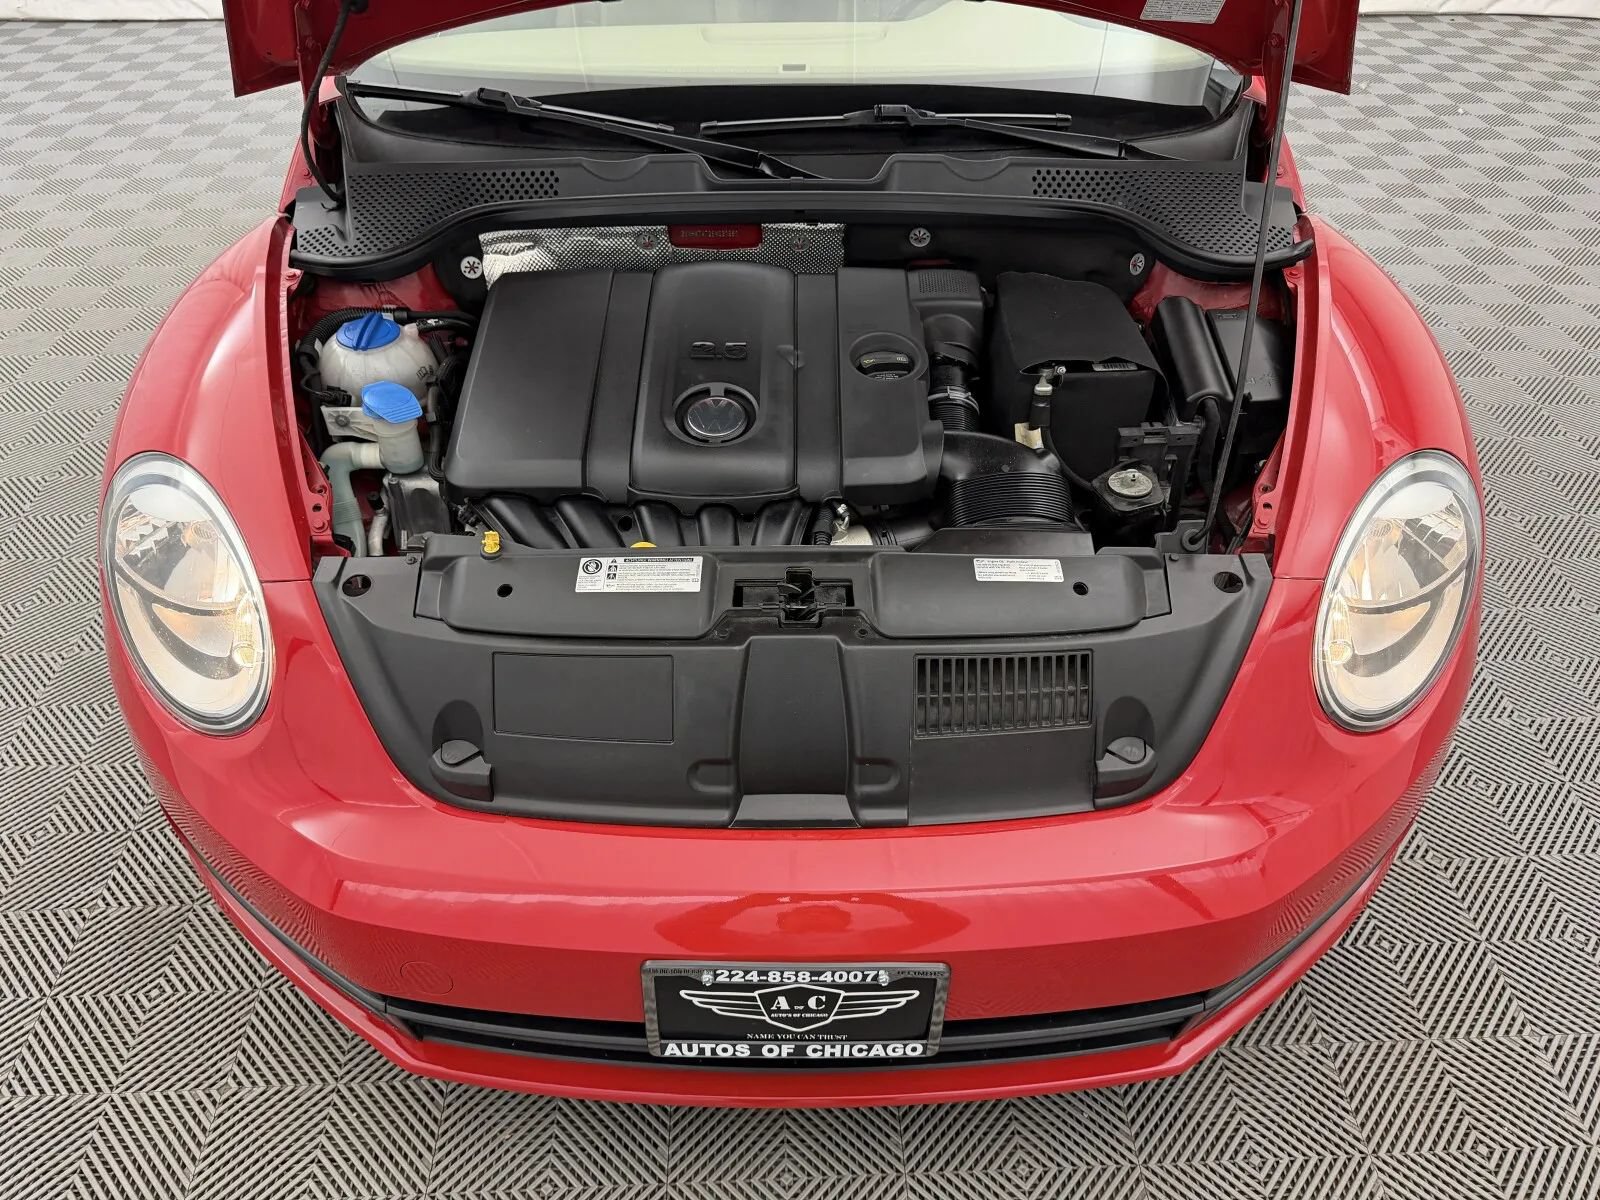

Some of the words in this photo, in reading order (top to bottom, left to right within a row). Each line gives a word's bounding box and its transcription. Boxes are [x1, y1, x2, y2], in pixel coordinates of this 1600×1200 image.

[690, 340, 748, 360] 2.5
[715, 969, 879, 984] 224-858-4007
[770, 995, 791, 1010] A
[807, 995, 826, 1010] C
[817, 1033, 848, 1041] TRUST
[663, 1042, 751, 1058] AUTOS
[761, 1043, 795, 1058] OF
[805, 1043, 924, 1058] CHICAGO
